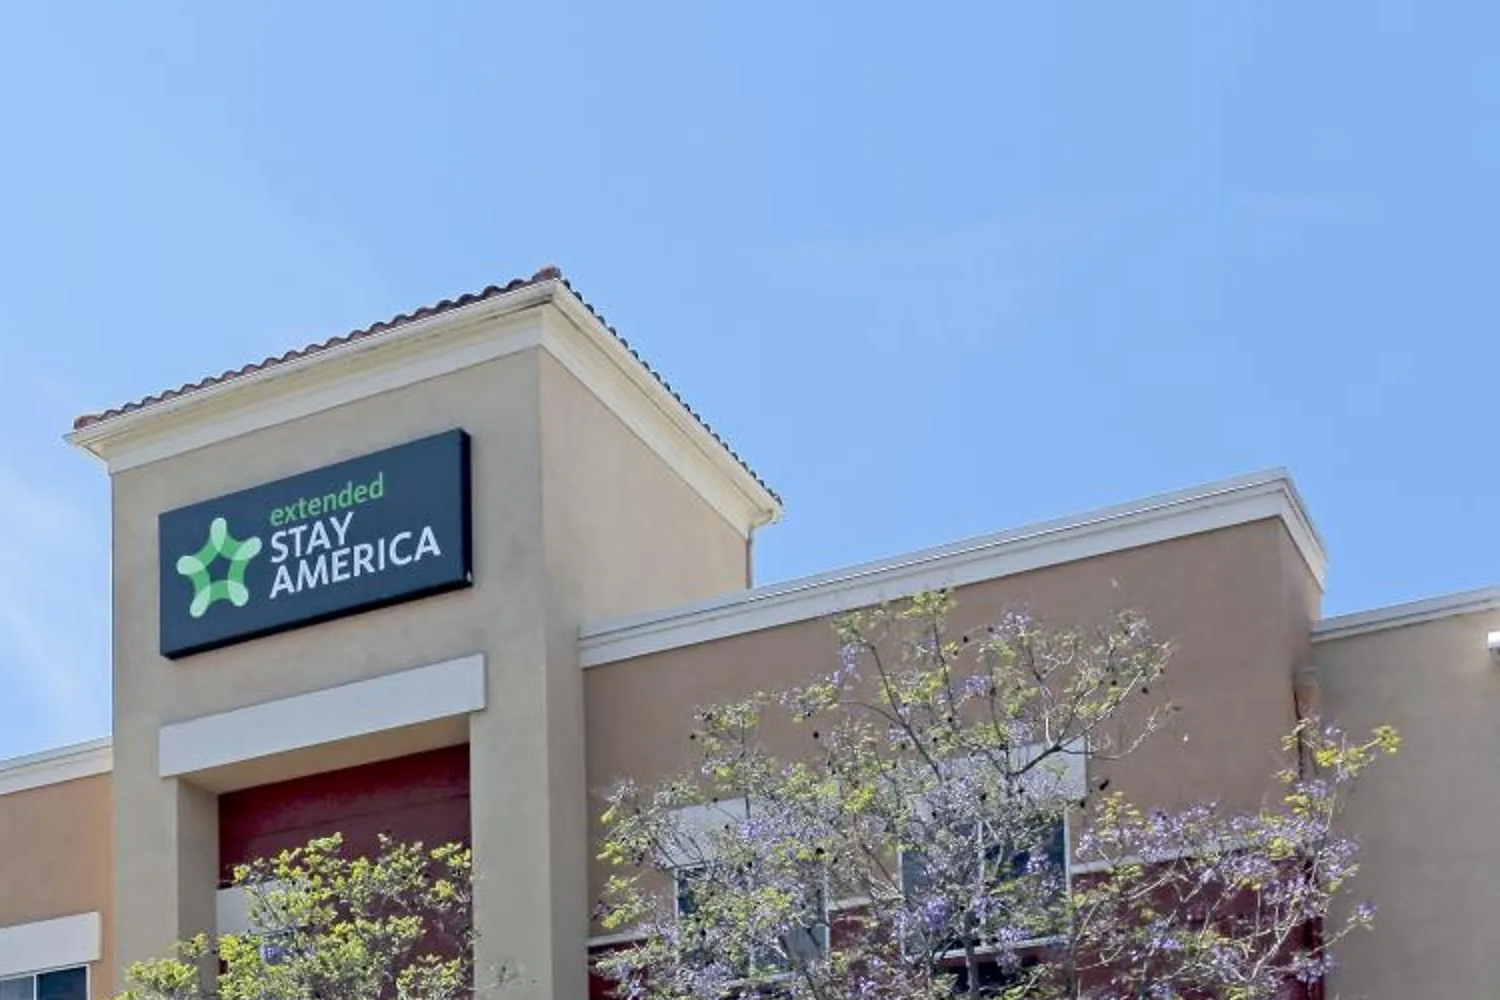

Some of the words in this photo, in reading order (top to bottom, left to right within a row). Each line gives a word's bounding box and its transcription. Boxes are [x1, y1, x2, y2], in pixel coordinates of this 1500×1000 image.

[270, 471, 383, 526] extended
[269, 526, 441, 599] AMERICA
[271, 511, 354, 563] STAY
